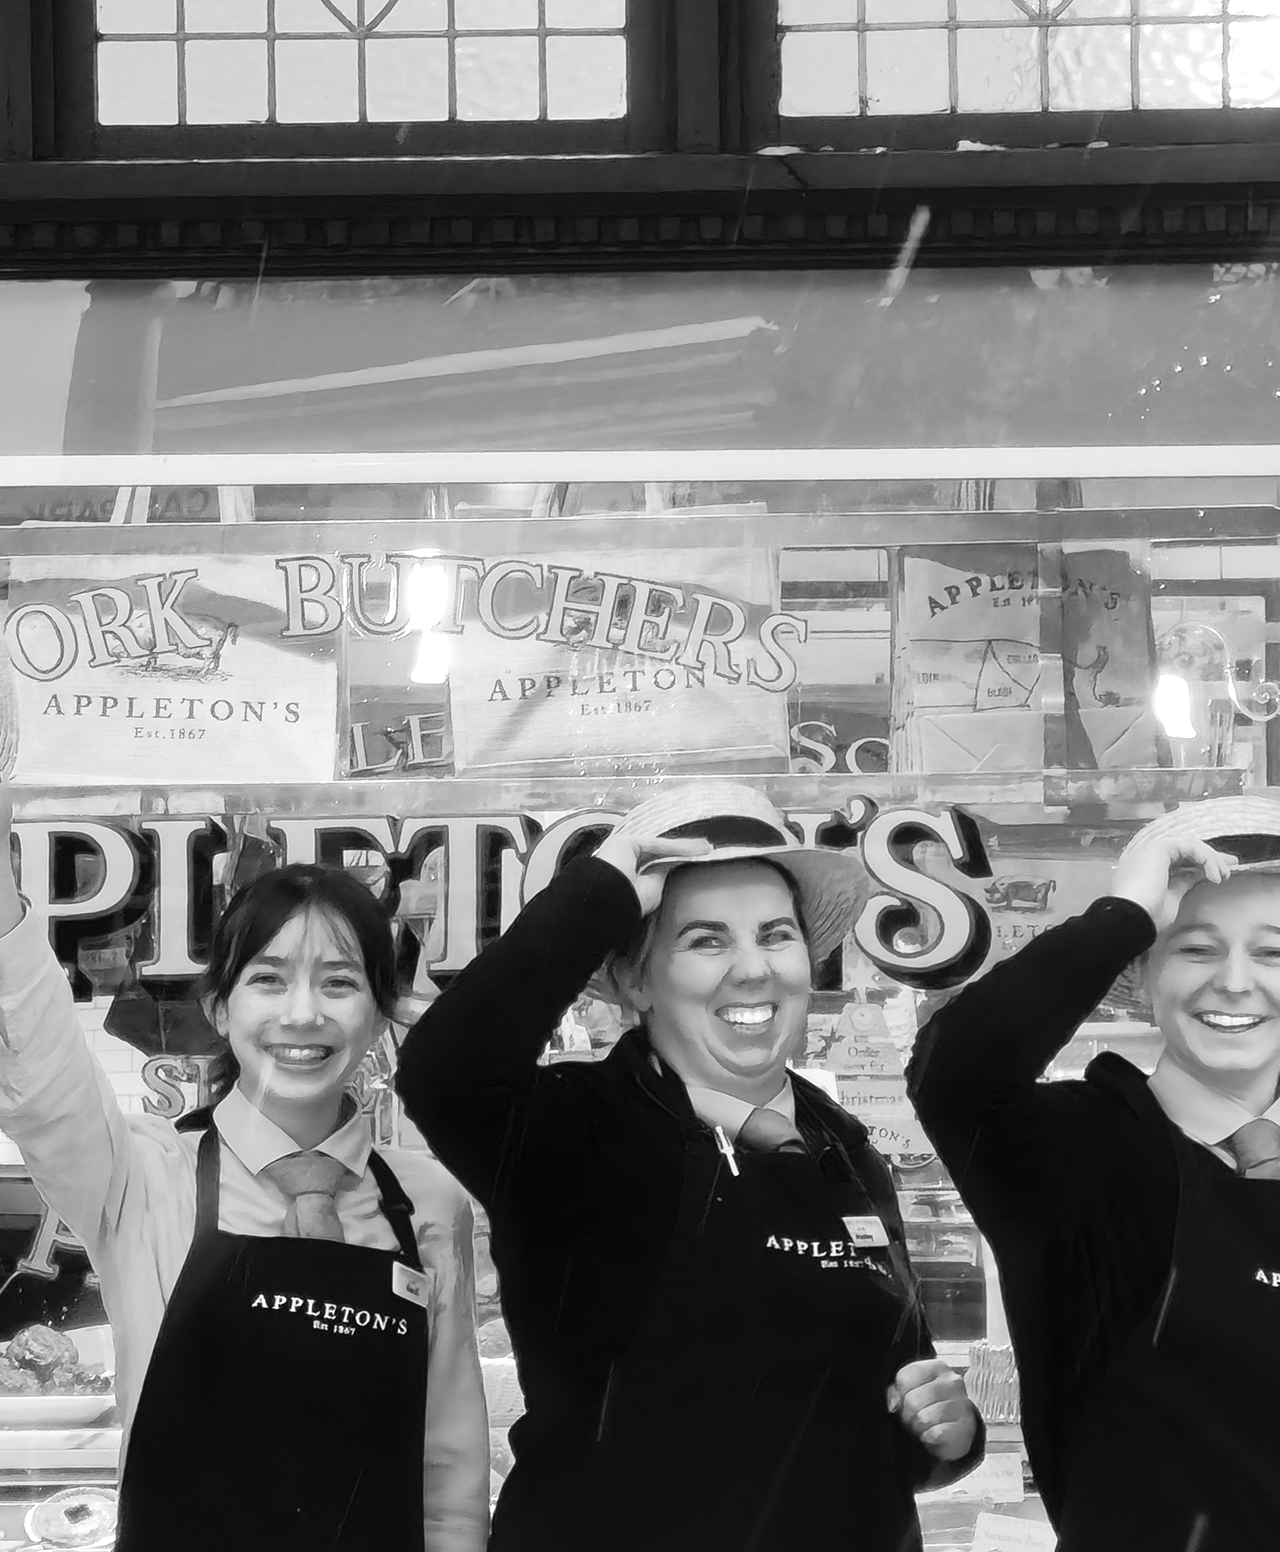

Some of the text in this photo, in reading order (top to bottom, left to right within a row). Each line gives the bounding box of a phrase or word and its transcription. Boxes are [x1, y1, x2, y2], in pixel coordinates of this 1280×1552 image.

[3, 554, 809, 694] ORK BUTCHERS
[42, 693, 301, 724] APPLETON'S
[251, 1293, 408, 1336] APPLETON'S
